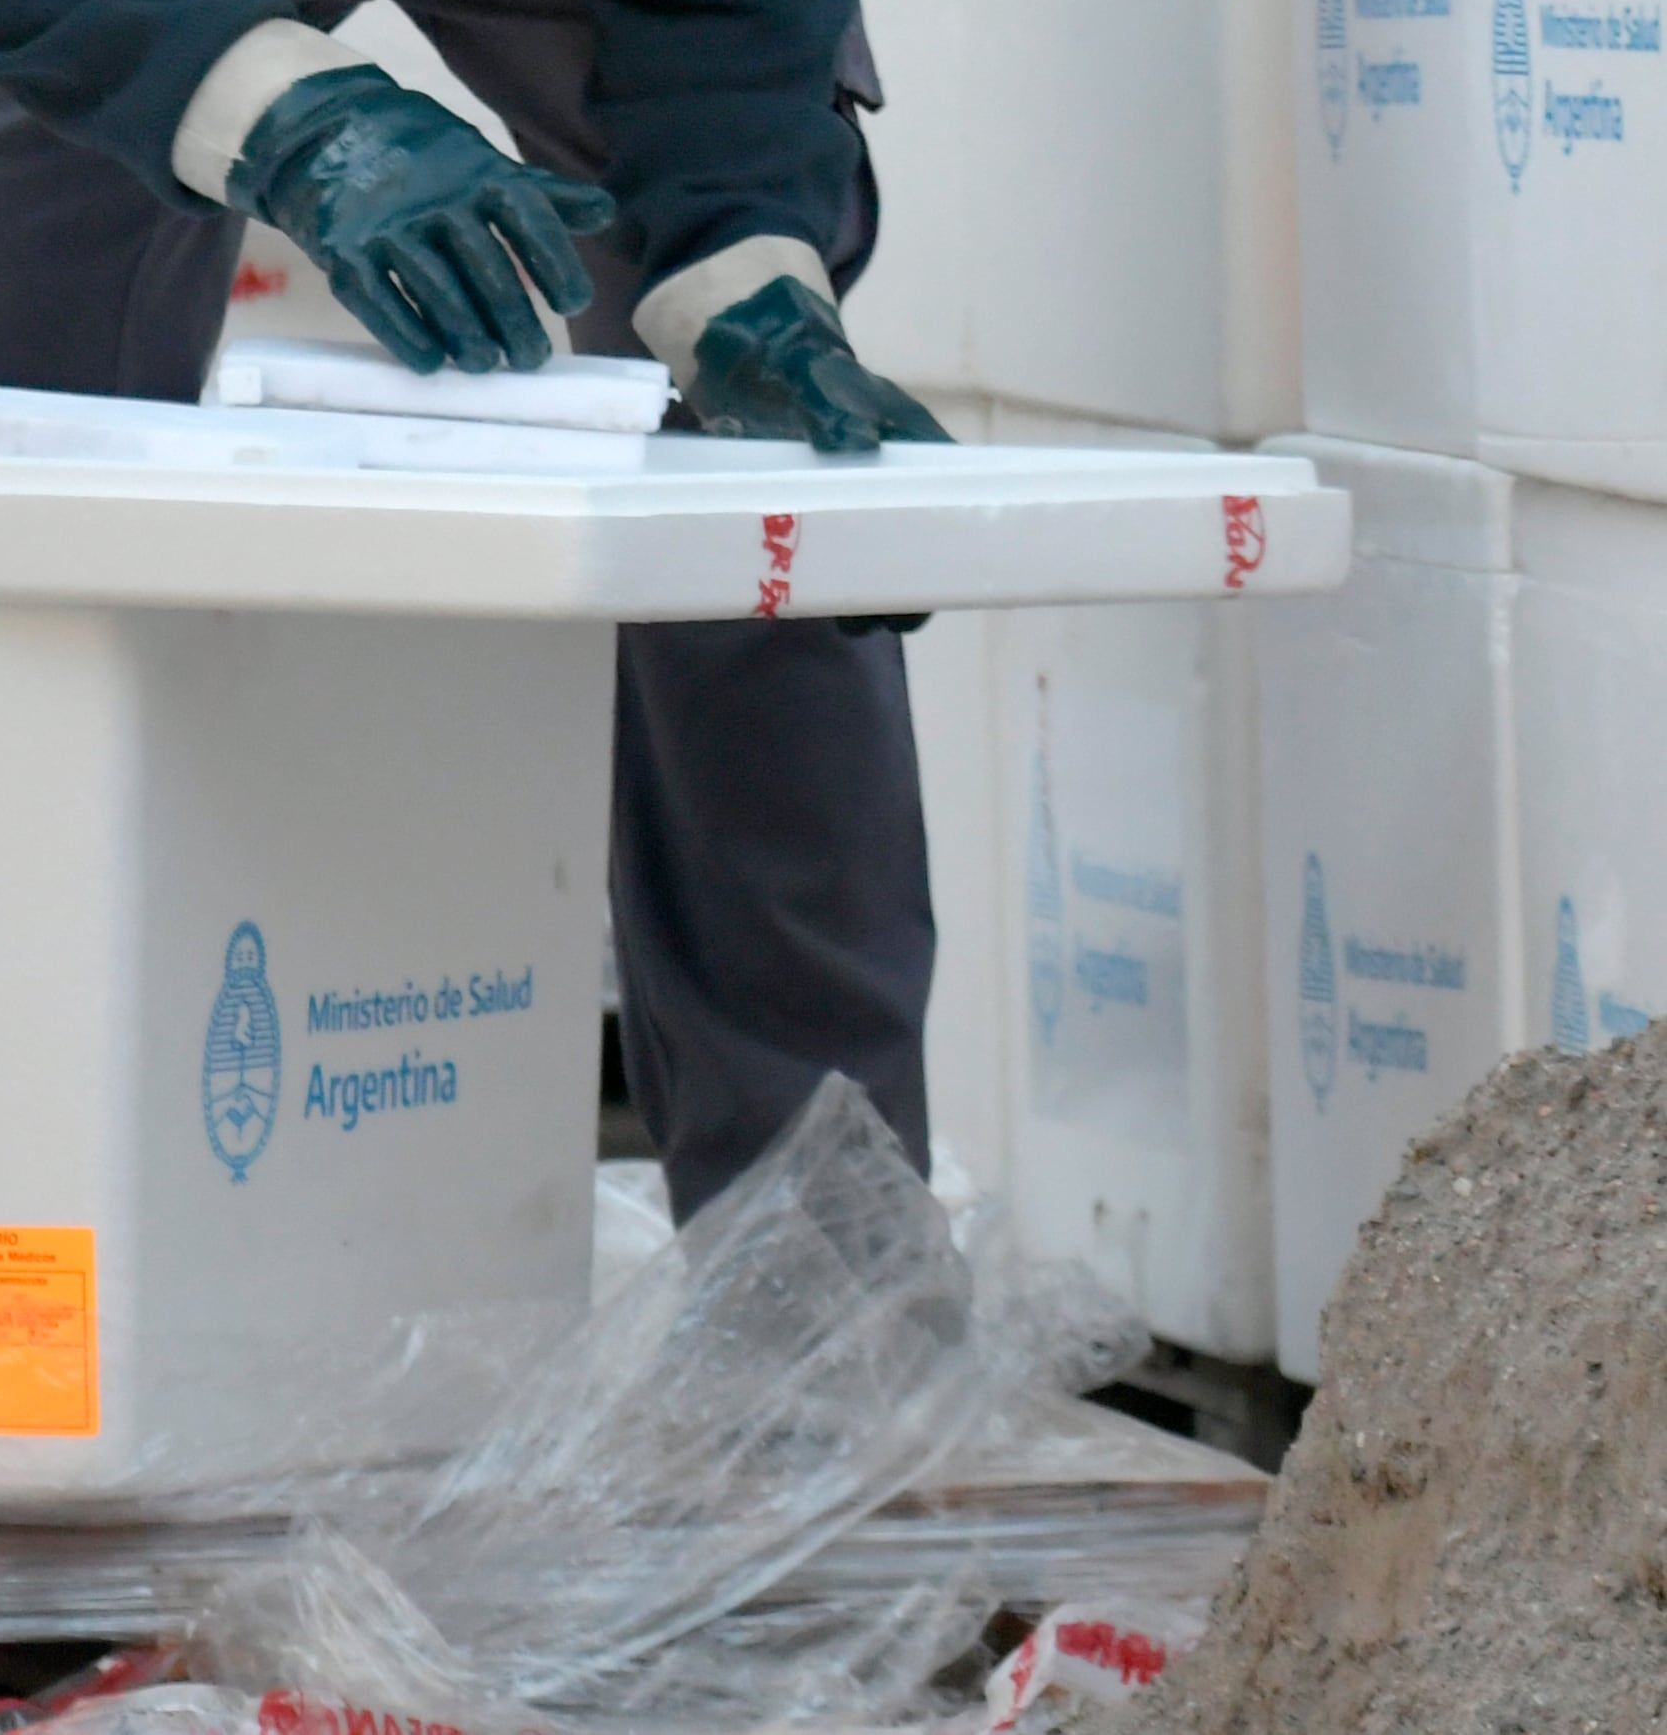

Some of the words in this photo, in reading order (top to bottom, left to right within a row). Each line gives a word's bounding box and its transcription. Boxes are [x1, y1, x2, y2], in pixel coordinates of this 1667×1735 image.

[308, 979, 430, 1037] Ministerio
[434, 974, 464, 1022] de
[468, 964, 534, 1017] Salud
[304, 1049, 458, 1133] Argentina
